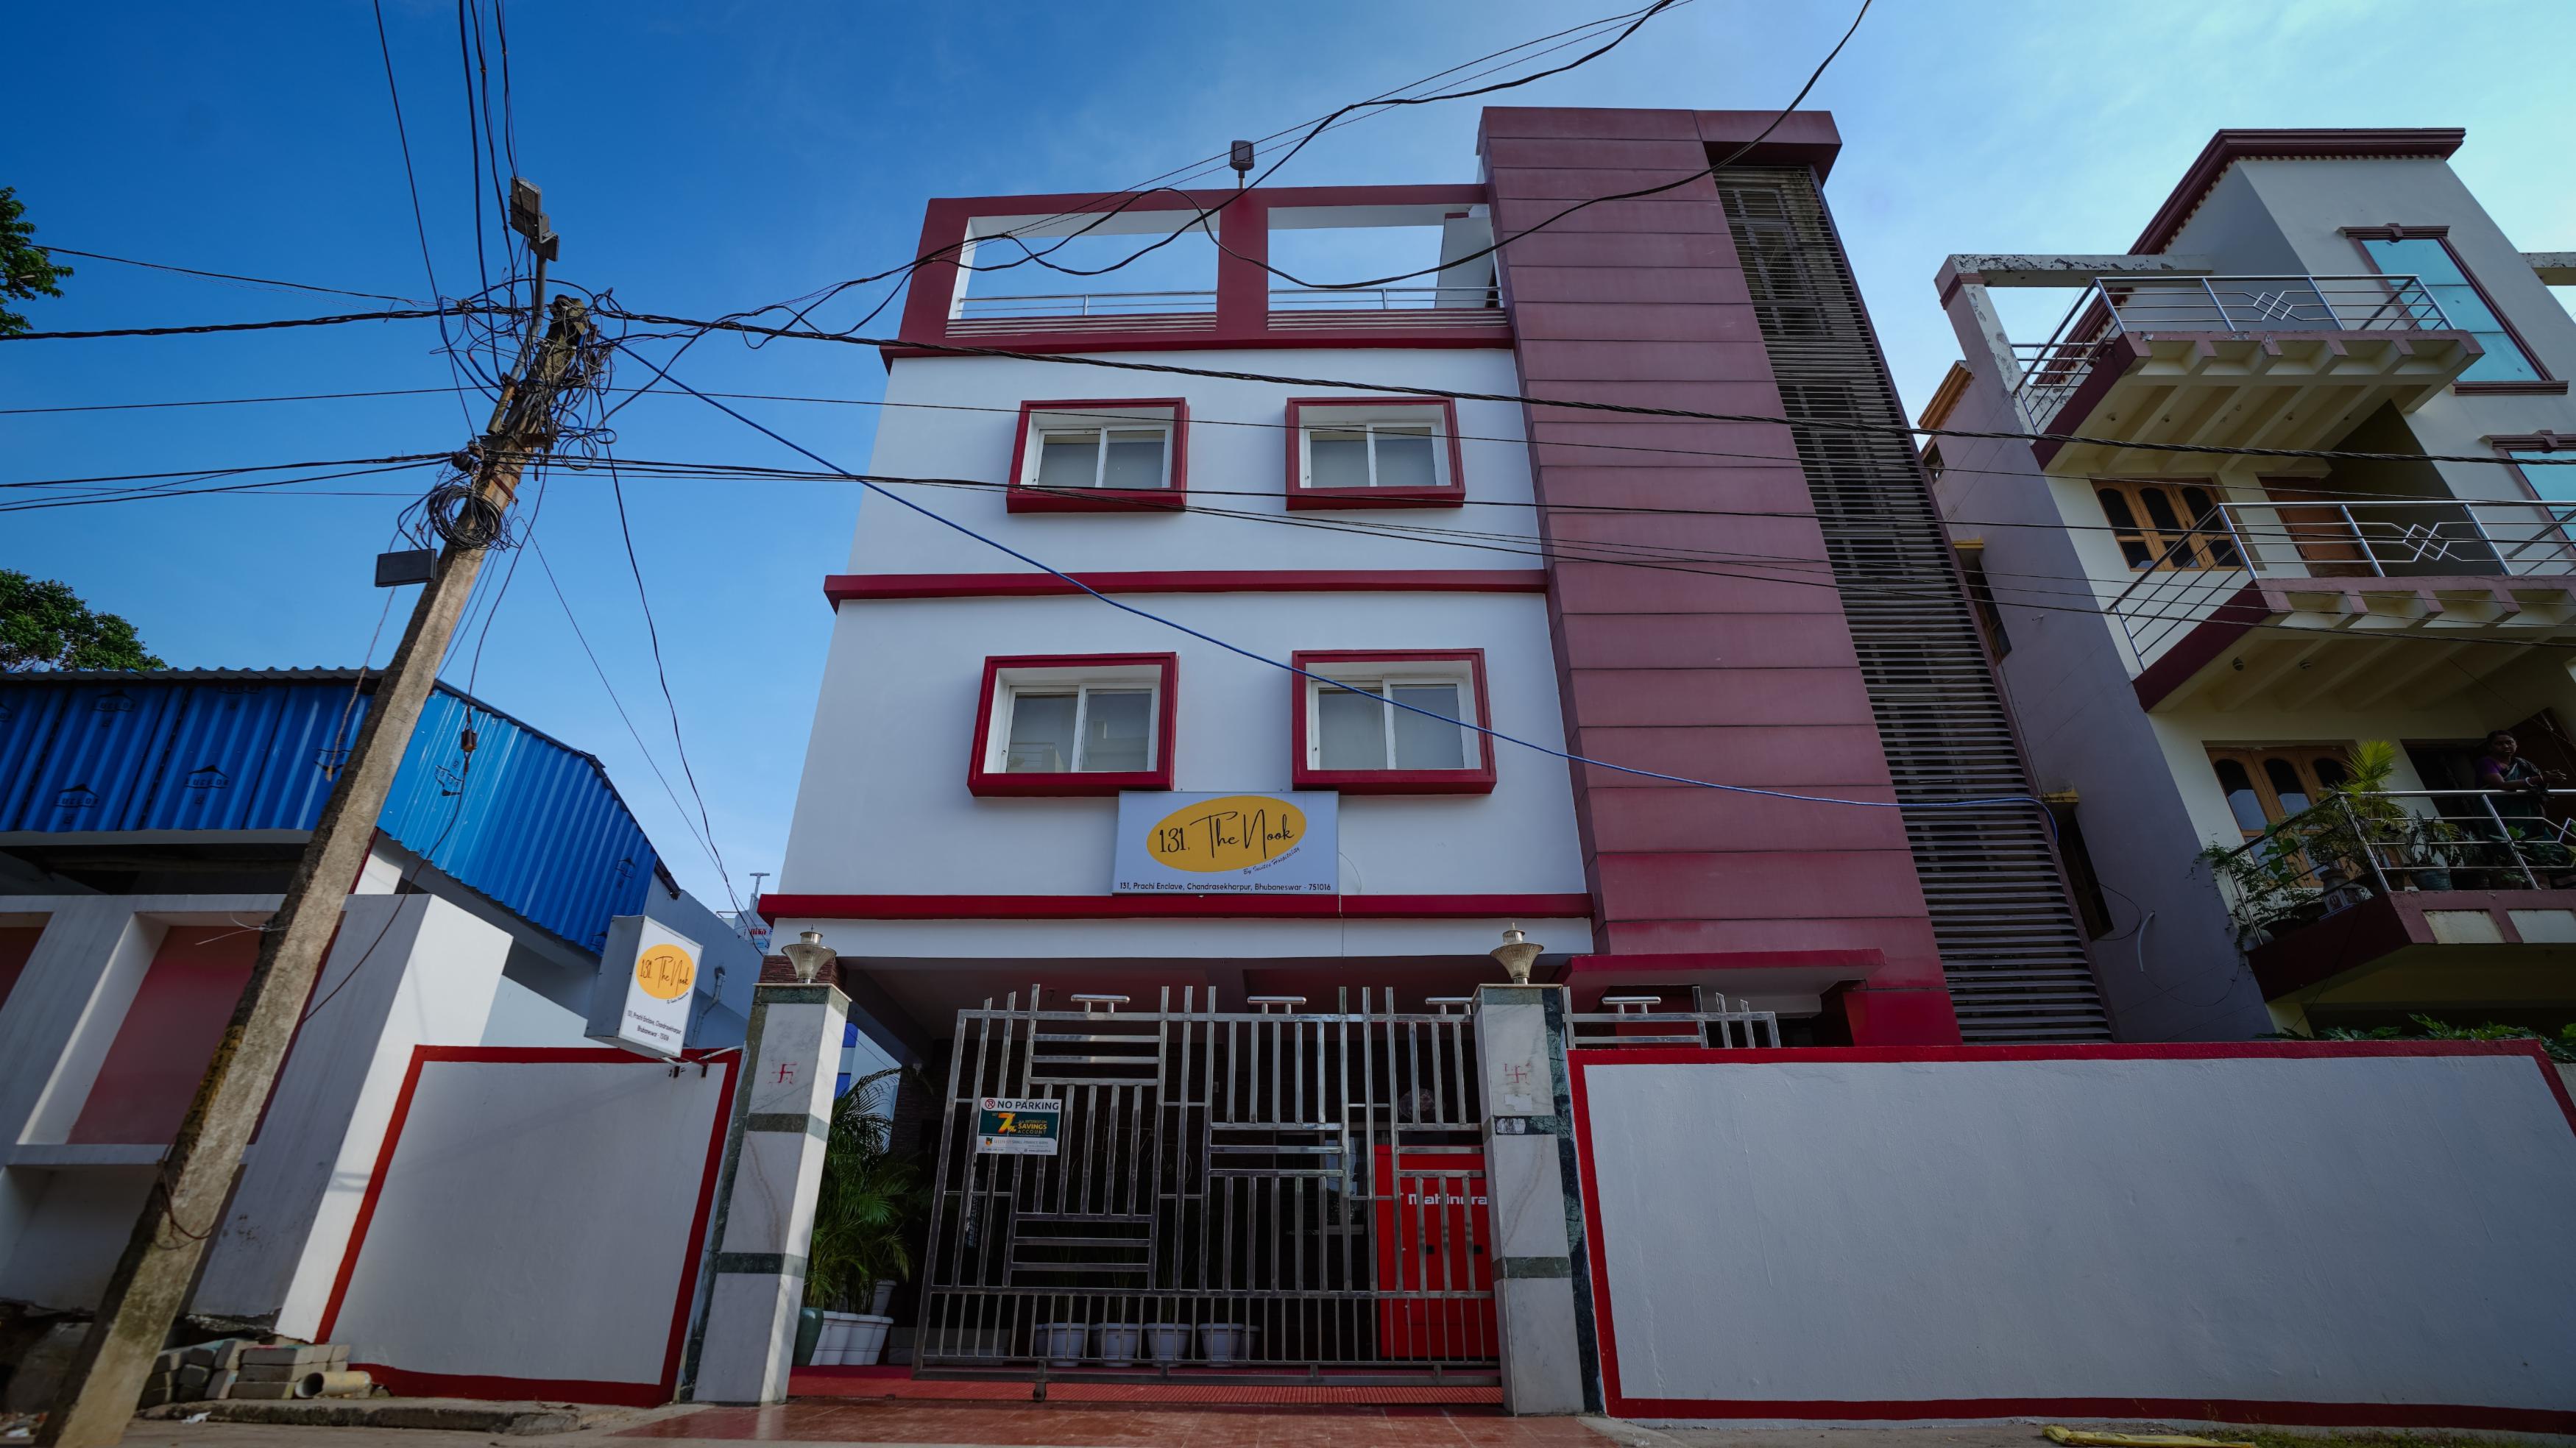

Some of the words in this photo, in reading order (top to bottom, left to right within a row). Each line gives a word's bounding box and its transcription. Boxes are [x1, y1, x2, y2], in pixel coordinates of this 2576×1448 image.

[1189, 811, 1239, 859] The
[1243, 809, 1294, 859] Nook
[1272, 847, 1301, 865] Hospitality
[1119, 882, 1131, 890] 131,
[1156, 882, 1185, 890] Enclave,
[1186, 882, 1253, 892] Chandrasekharpur,
[654, 956, 673, 989] The
[670, 959, 690, 996] Nook
[997, 1101, 1013, 1109] NO
[1016, 1101, 1059, 1110] PARKING
